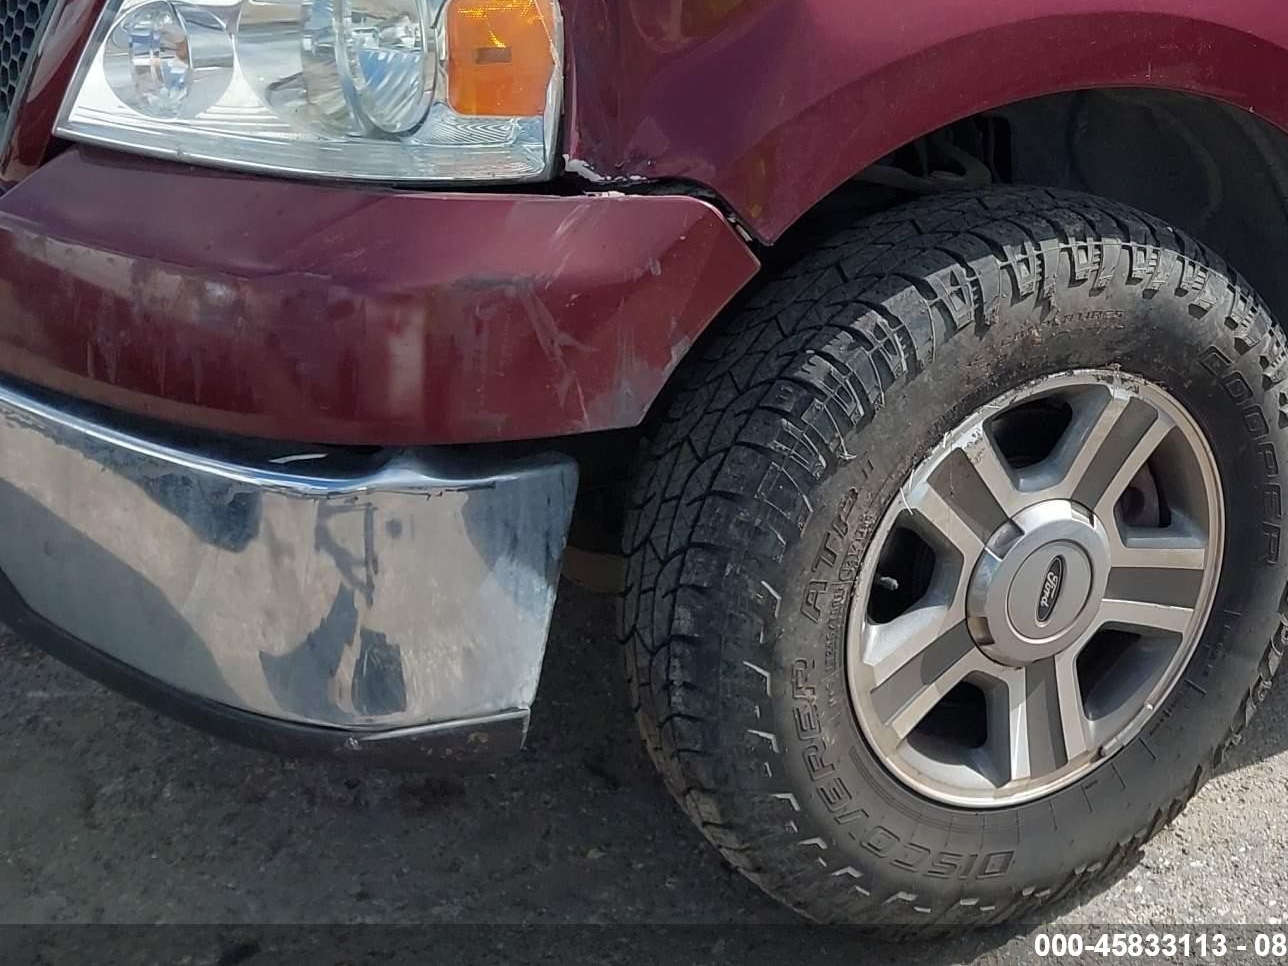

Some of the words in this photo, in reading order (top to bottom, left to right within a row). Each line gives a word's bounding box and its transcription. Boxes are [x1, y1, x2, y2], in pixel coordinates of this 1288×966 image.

[1200, 344, 1282, 565] COOPER
[1040, 571, 1058, 608] Ford
[791, 657, 1015, 880] DISCOVERER
